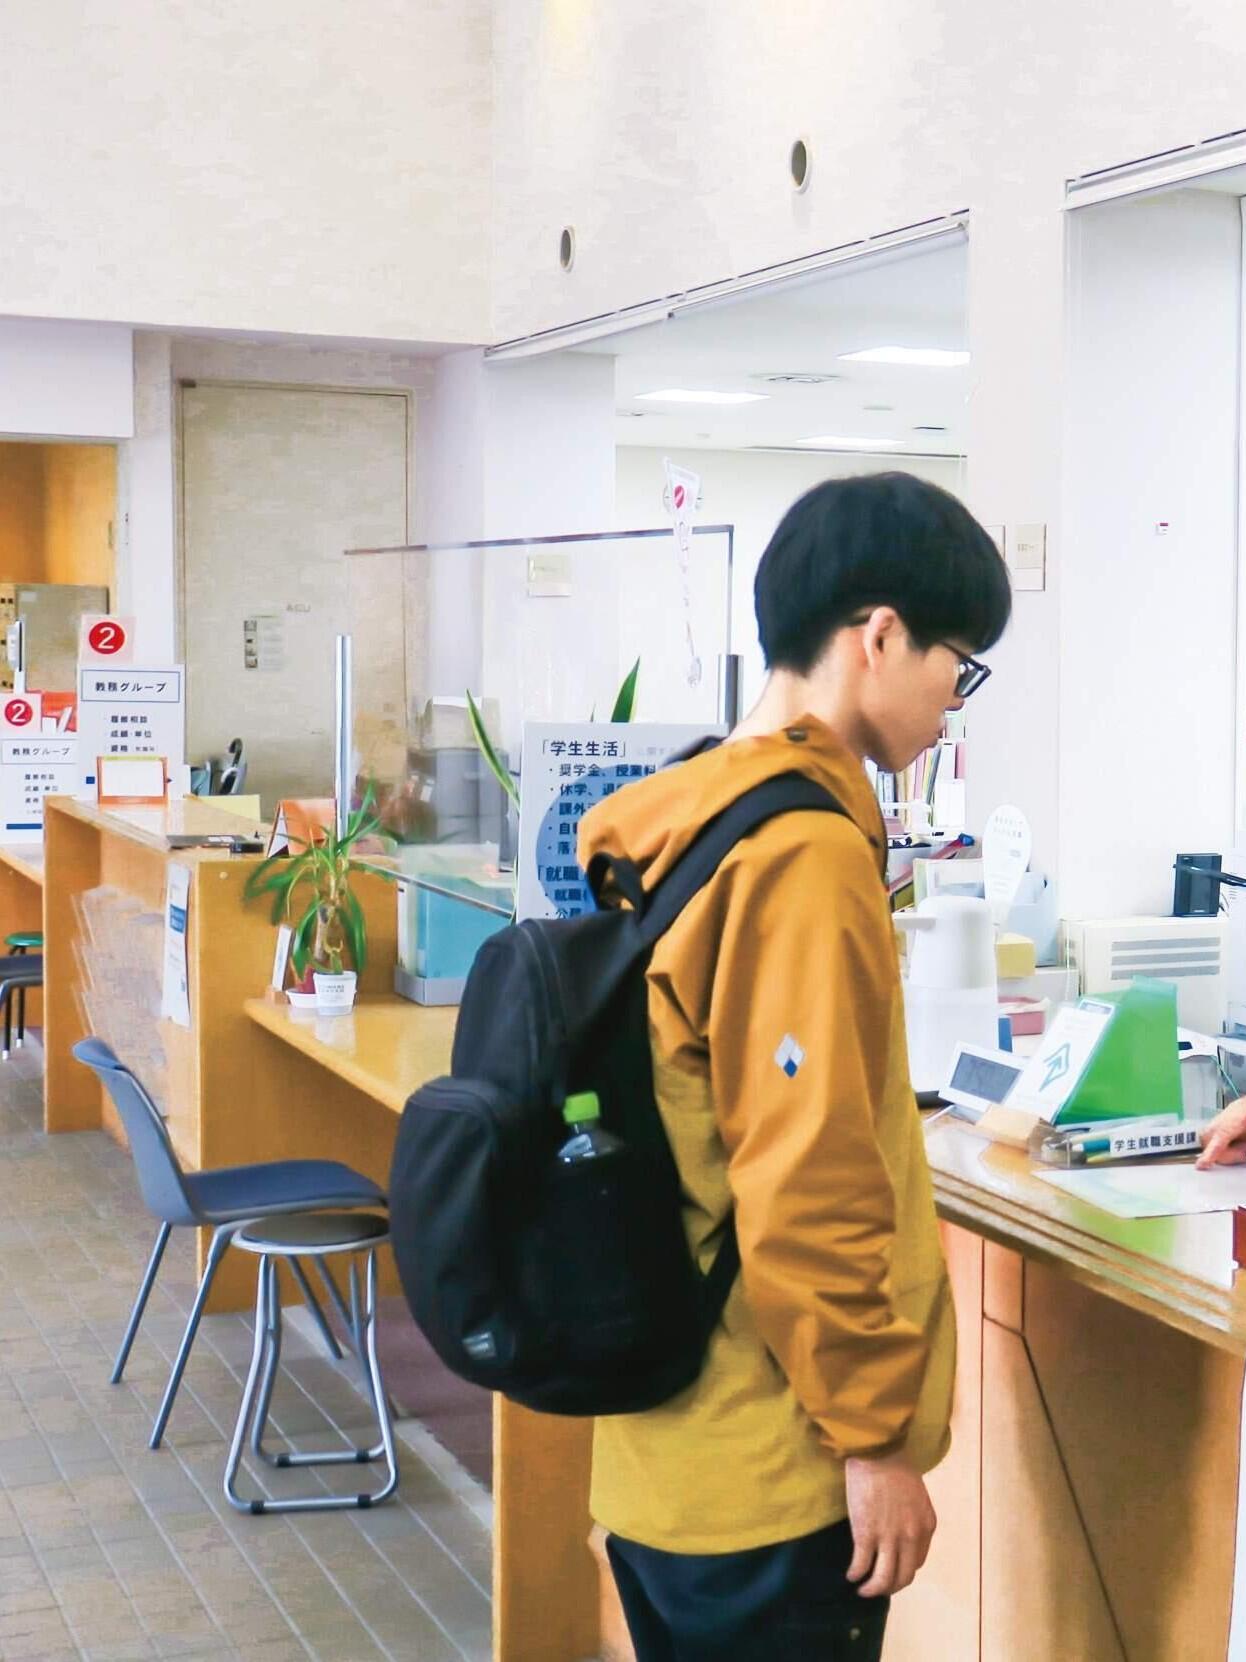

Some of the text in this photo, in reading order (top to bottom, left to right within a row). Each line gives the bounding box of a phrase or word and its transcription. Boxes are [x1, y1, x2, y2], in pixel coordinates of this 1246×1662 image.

[1113, 1130, 1197, 1152] 学生就職支援課
